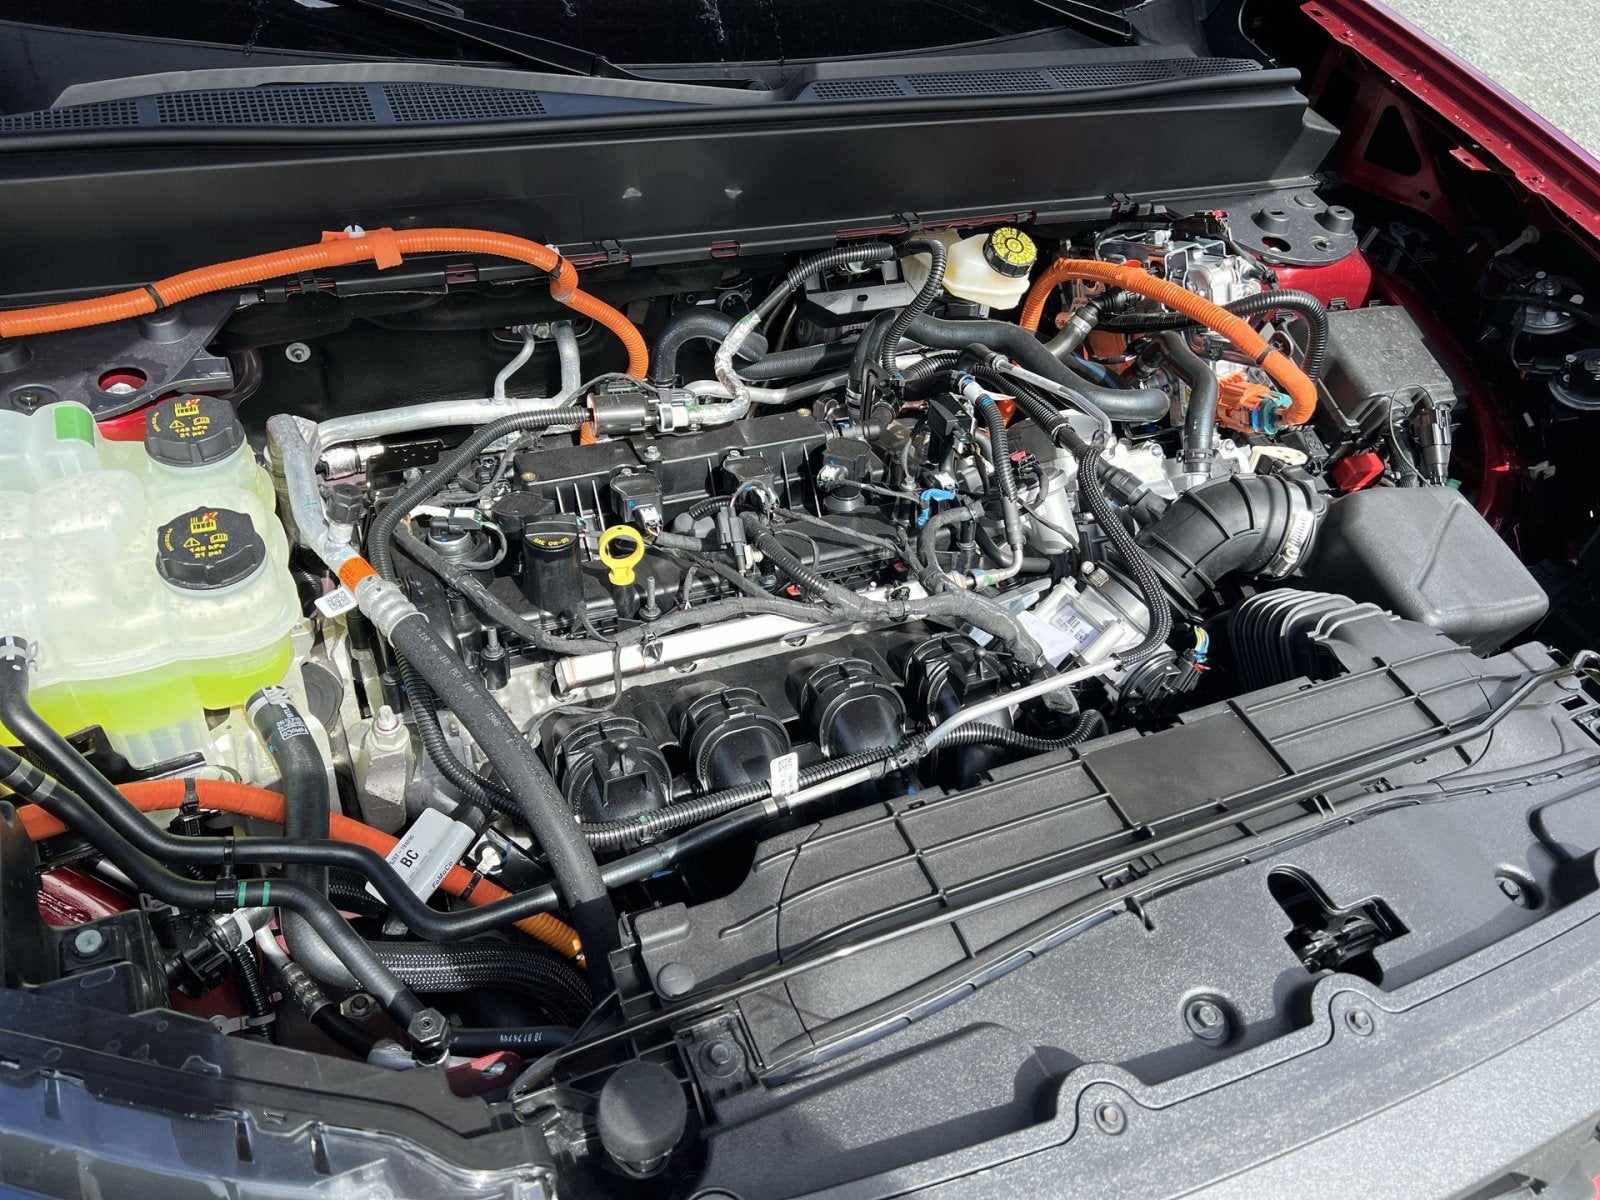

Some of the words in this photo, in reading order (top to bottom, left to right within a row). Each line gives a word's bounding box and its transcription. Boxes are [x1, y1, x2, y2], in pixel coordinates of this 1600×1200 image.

[208, 549, 222, 557] psi
[400, 849, 419, 868] BC
[431, 861, 453, 889] FoMoCo
